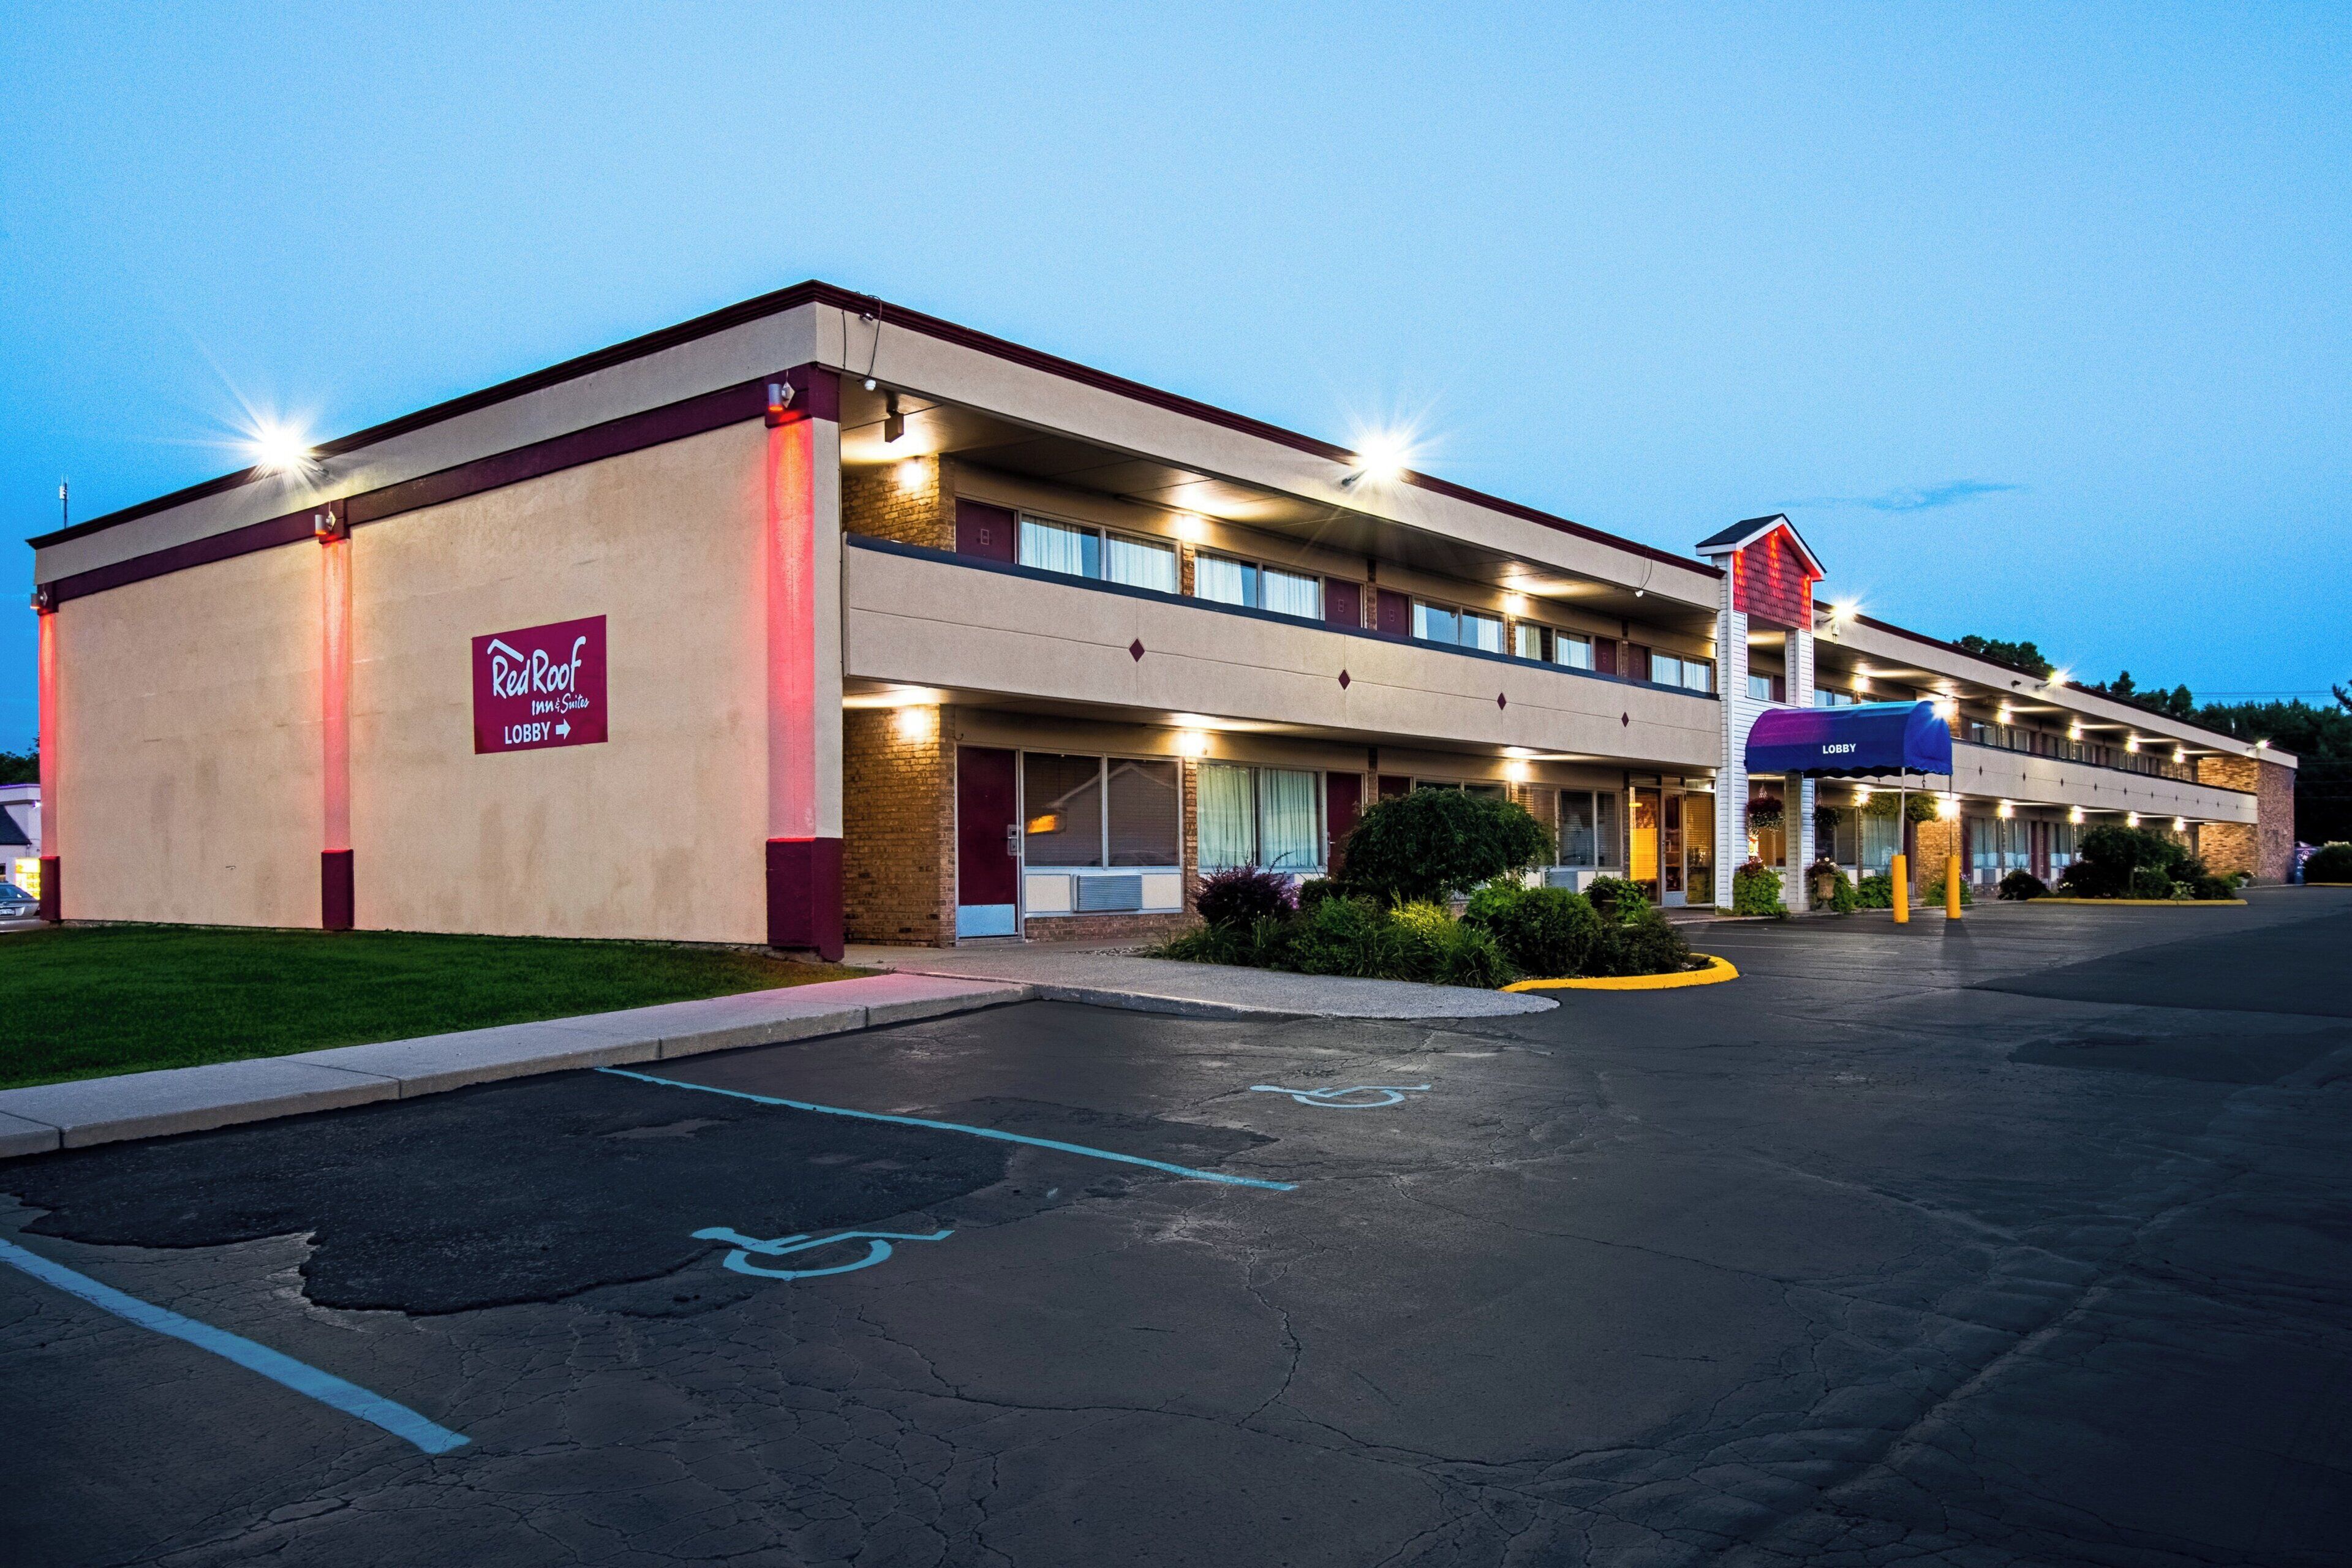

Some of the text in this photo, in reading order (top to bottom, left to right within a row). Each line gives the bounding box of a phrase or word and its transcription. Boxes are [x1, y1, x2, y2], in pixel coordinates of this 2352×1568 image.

[532, 693, 590, 716] Inn & Suites
[505, 722, 551, 744] LOBBY
[1822, 743, 1856, 755] LOBBY
